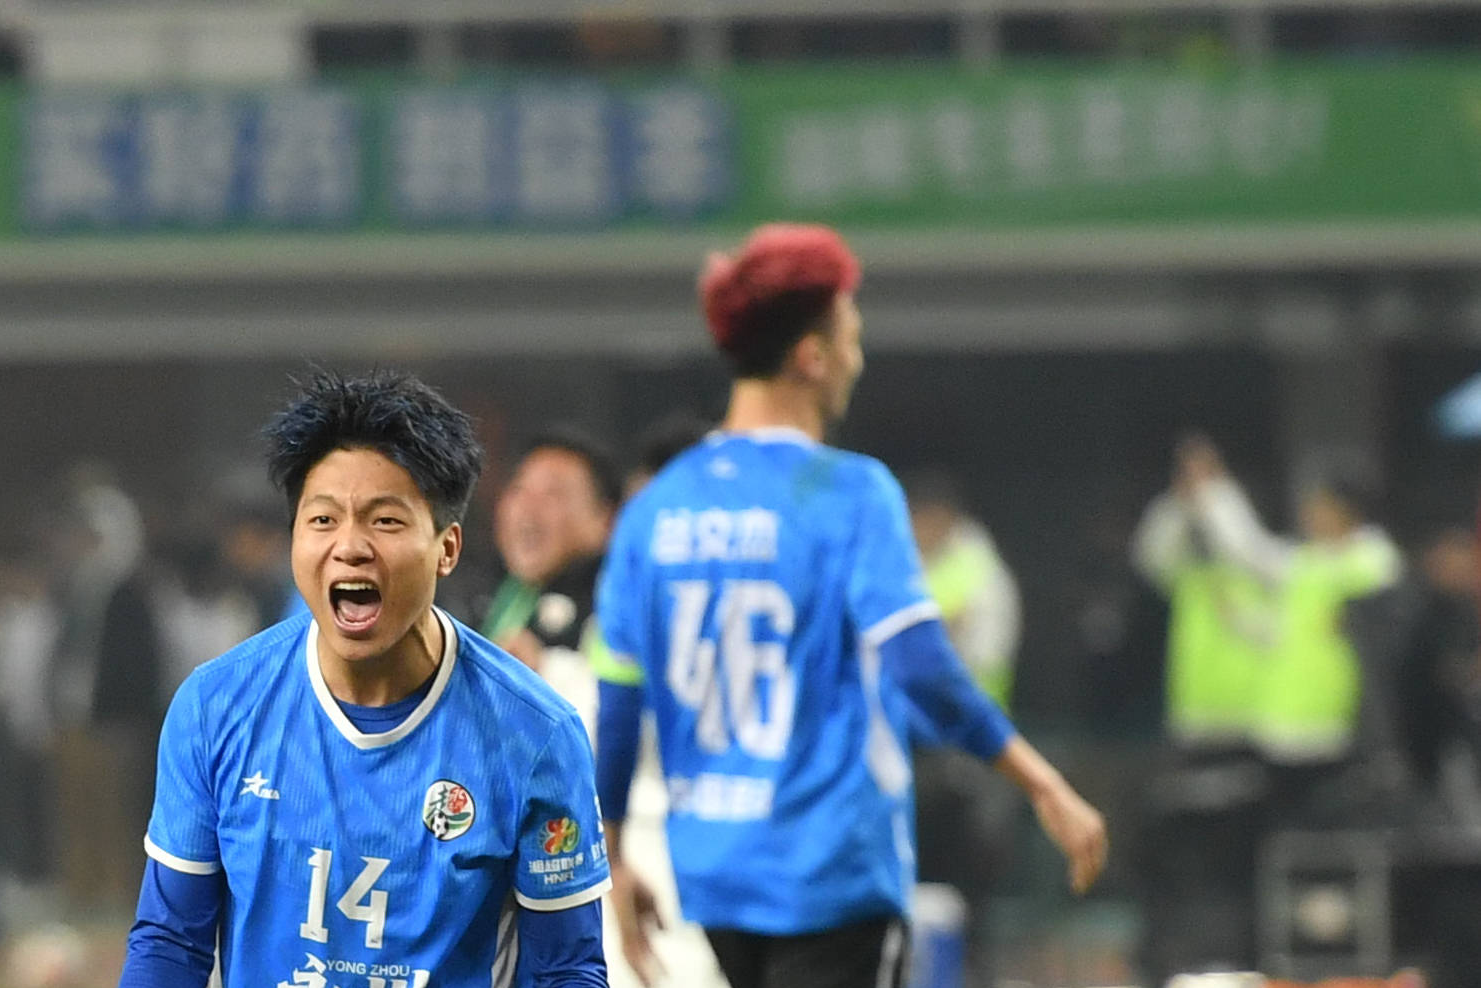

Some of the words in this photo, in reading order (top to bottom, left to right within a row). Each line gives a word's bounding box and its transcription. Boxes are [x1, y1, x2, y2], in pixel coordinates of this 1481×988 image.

[666, 576, 796, 762] 46
[299, 846, 390, 949] 14
[326, 959, 367, 975] YONG
[370, 964, 411, 977] ZHOU
